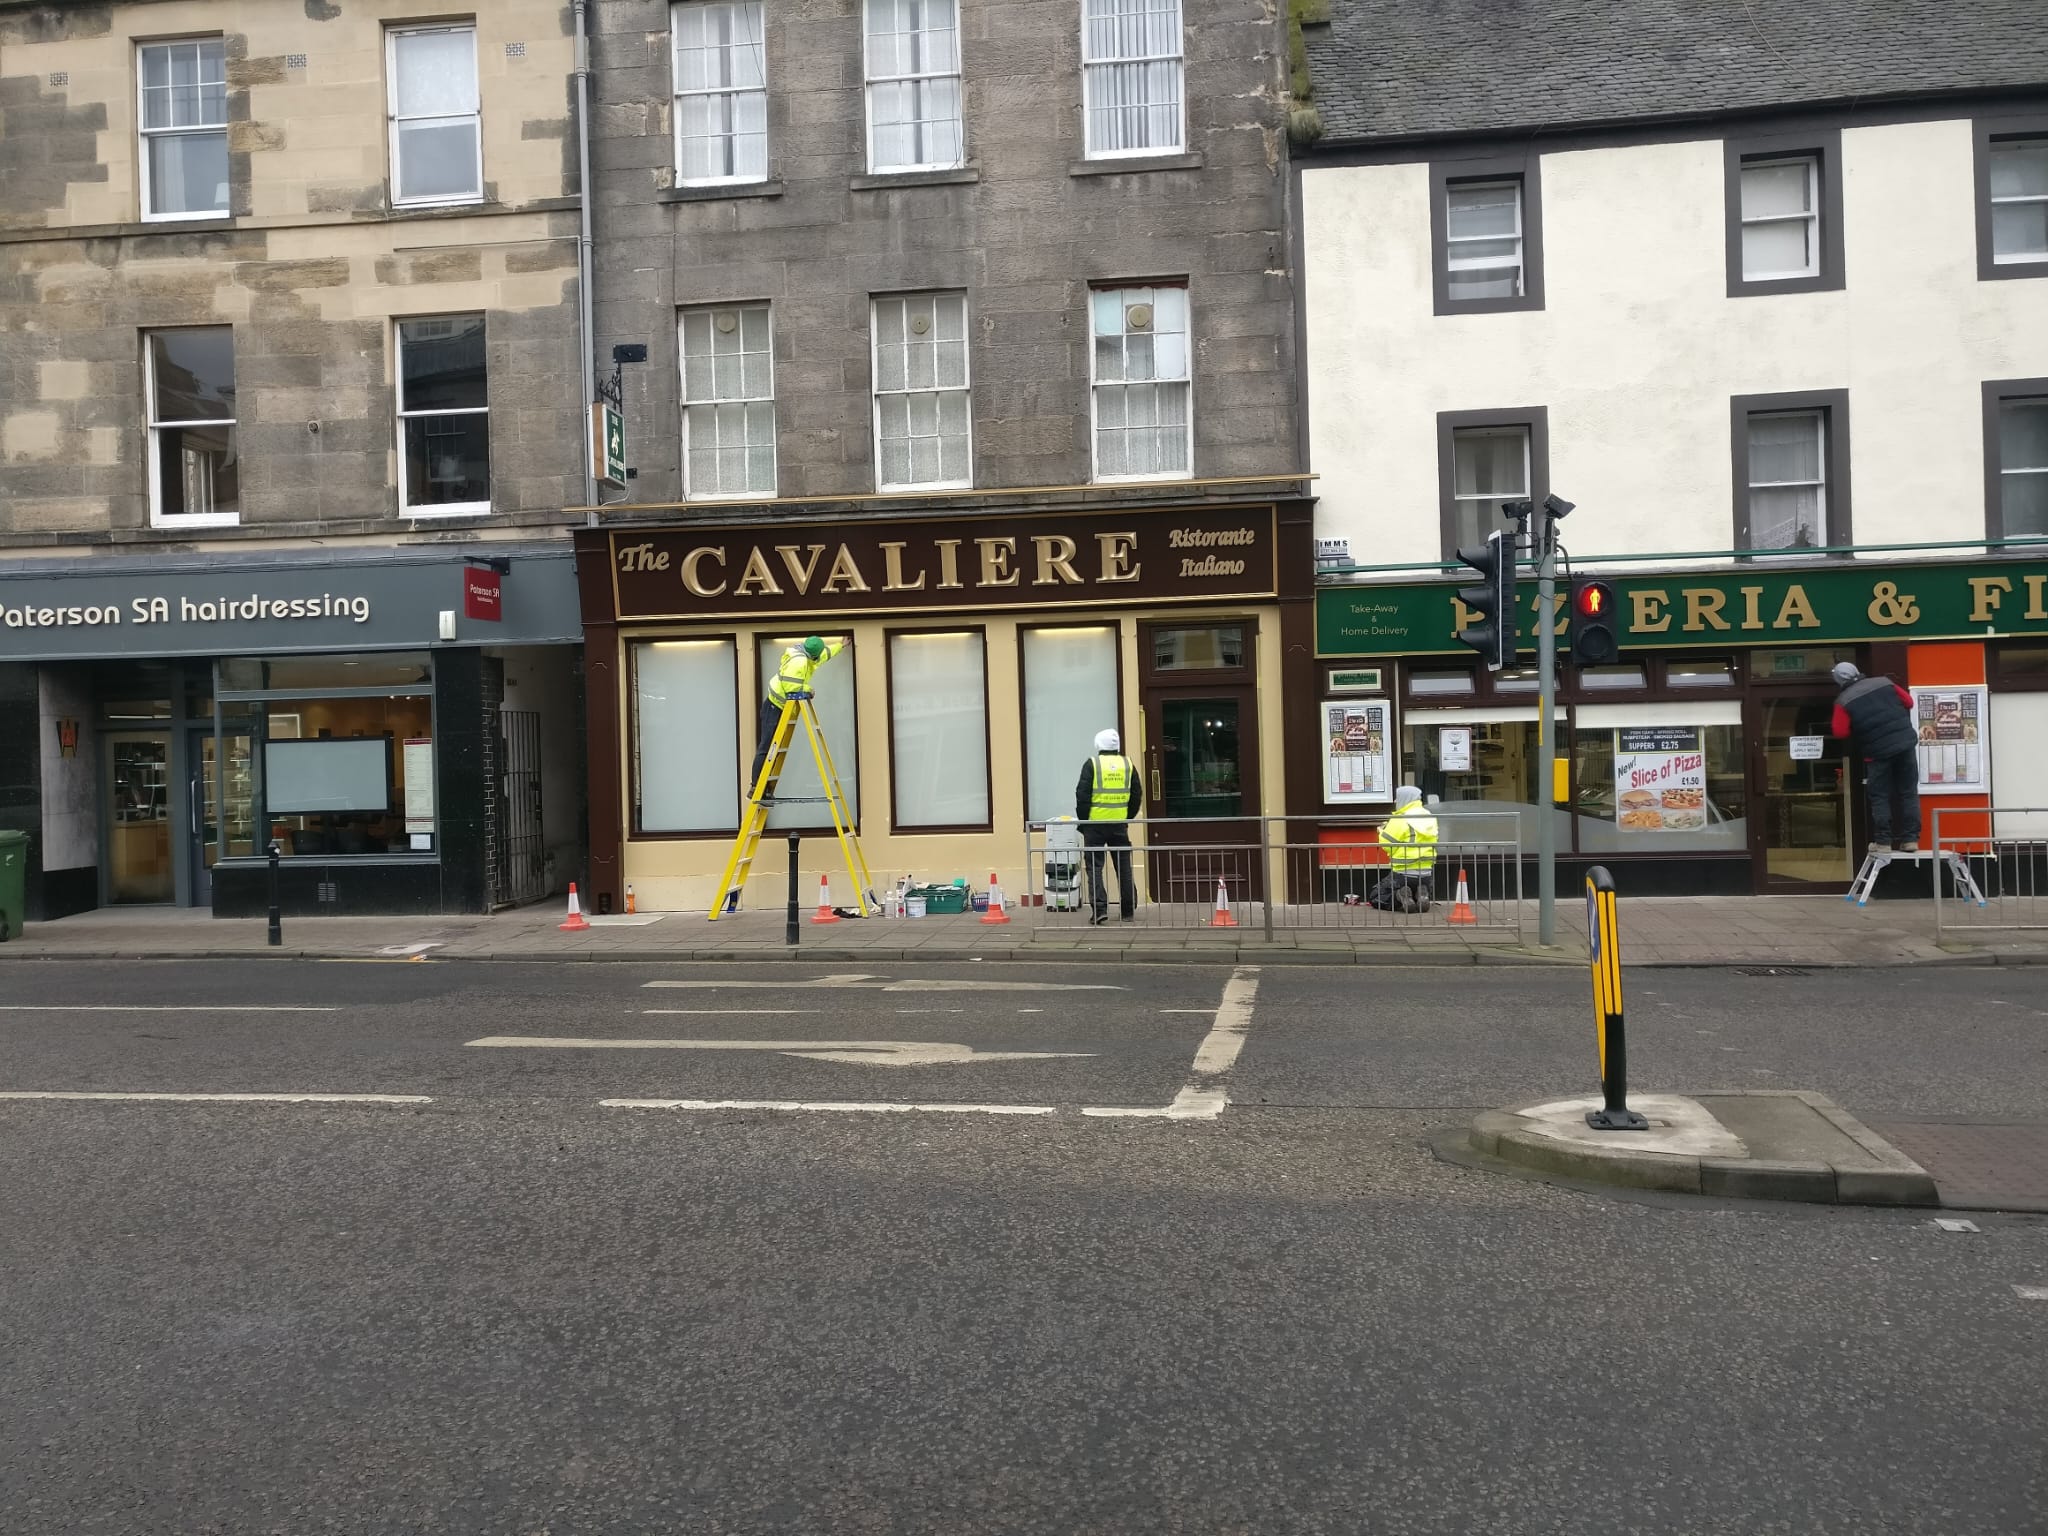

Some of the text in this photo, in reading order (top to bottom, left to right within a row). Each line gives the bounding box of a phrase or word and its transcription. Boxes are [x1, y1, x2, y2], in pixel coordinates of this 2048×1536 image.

[1169, 527, 1256, 548] Ristorante
[618, 543, 670, 572] The
[681, 532, 1141, 598] CAVALIERE
[1179, 554, 1246, 577] Italiano
[0, 593, 370, 628] aterson SA hairdressing
[1349, 604, 1399, 614] Take-Away
[1450, 584, 1821, 639] PZERIA
[1867, 581, 1921, 626] &
[1341, 626, 1409, 637] Home Delivery
[1629, 741, 1679, 750] SUPPERS £2.75
[1618, 755, 1637, 778] New!
[1631, 754, 1702, 788] Slice of Pizza
[1681, 777, 1699, 786] £1.50
